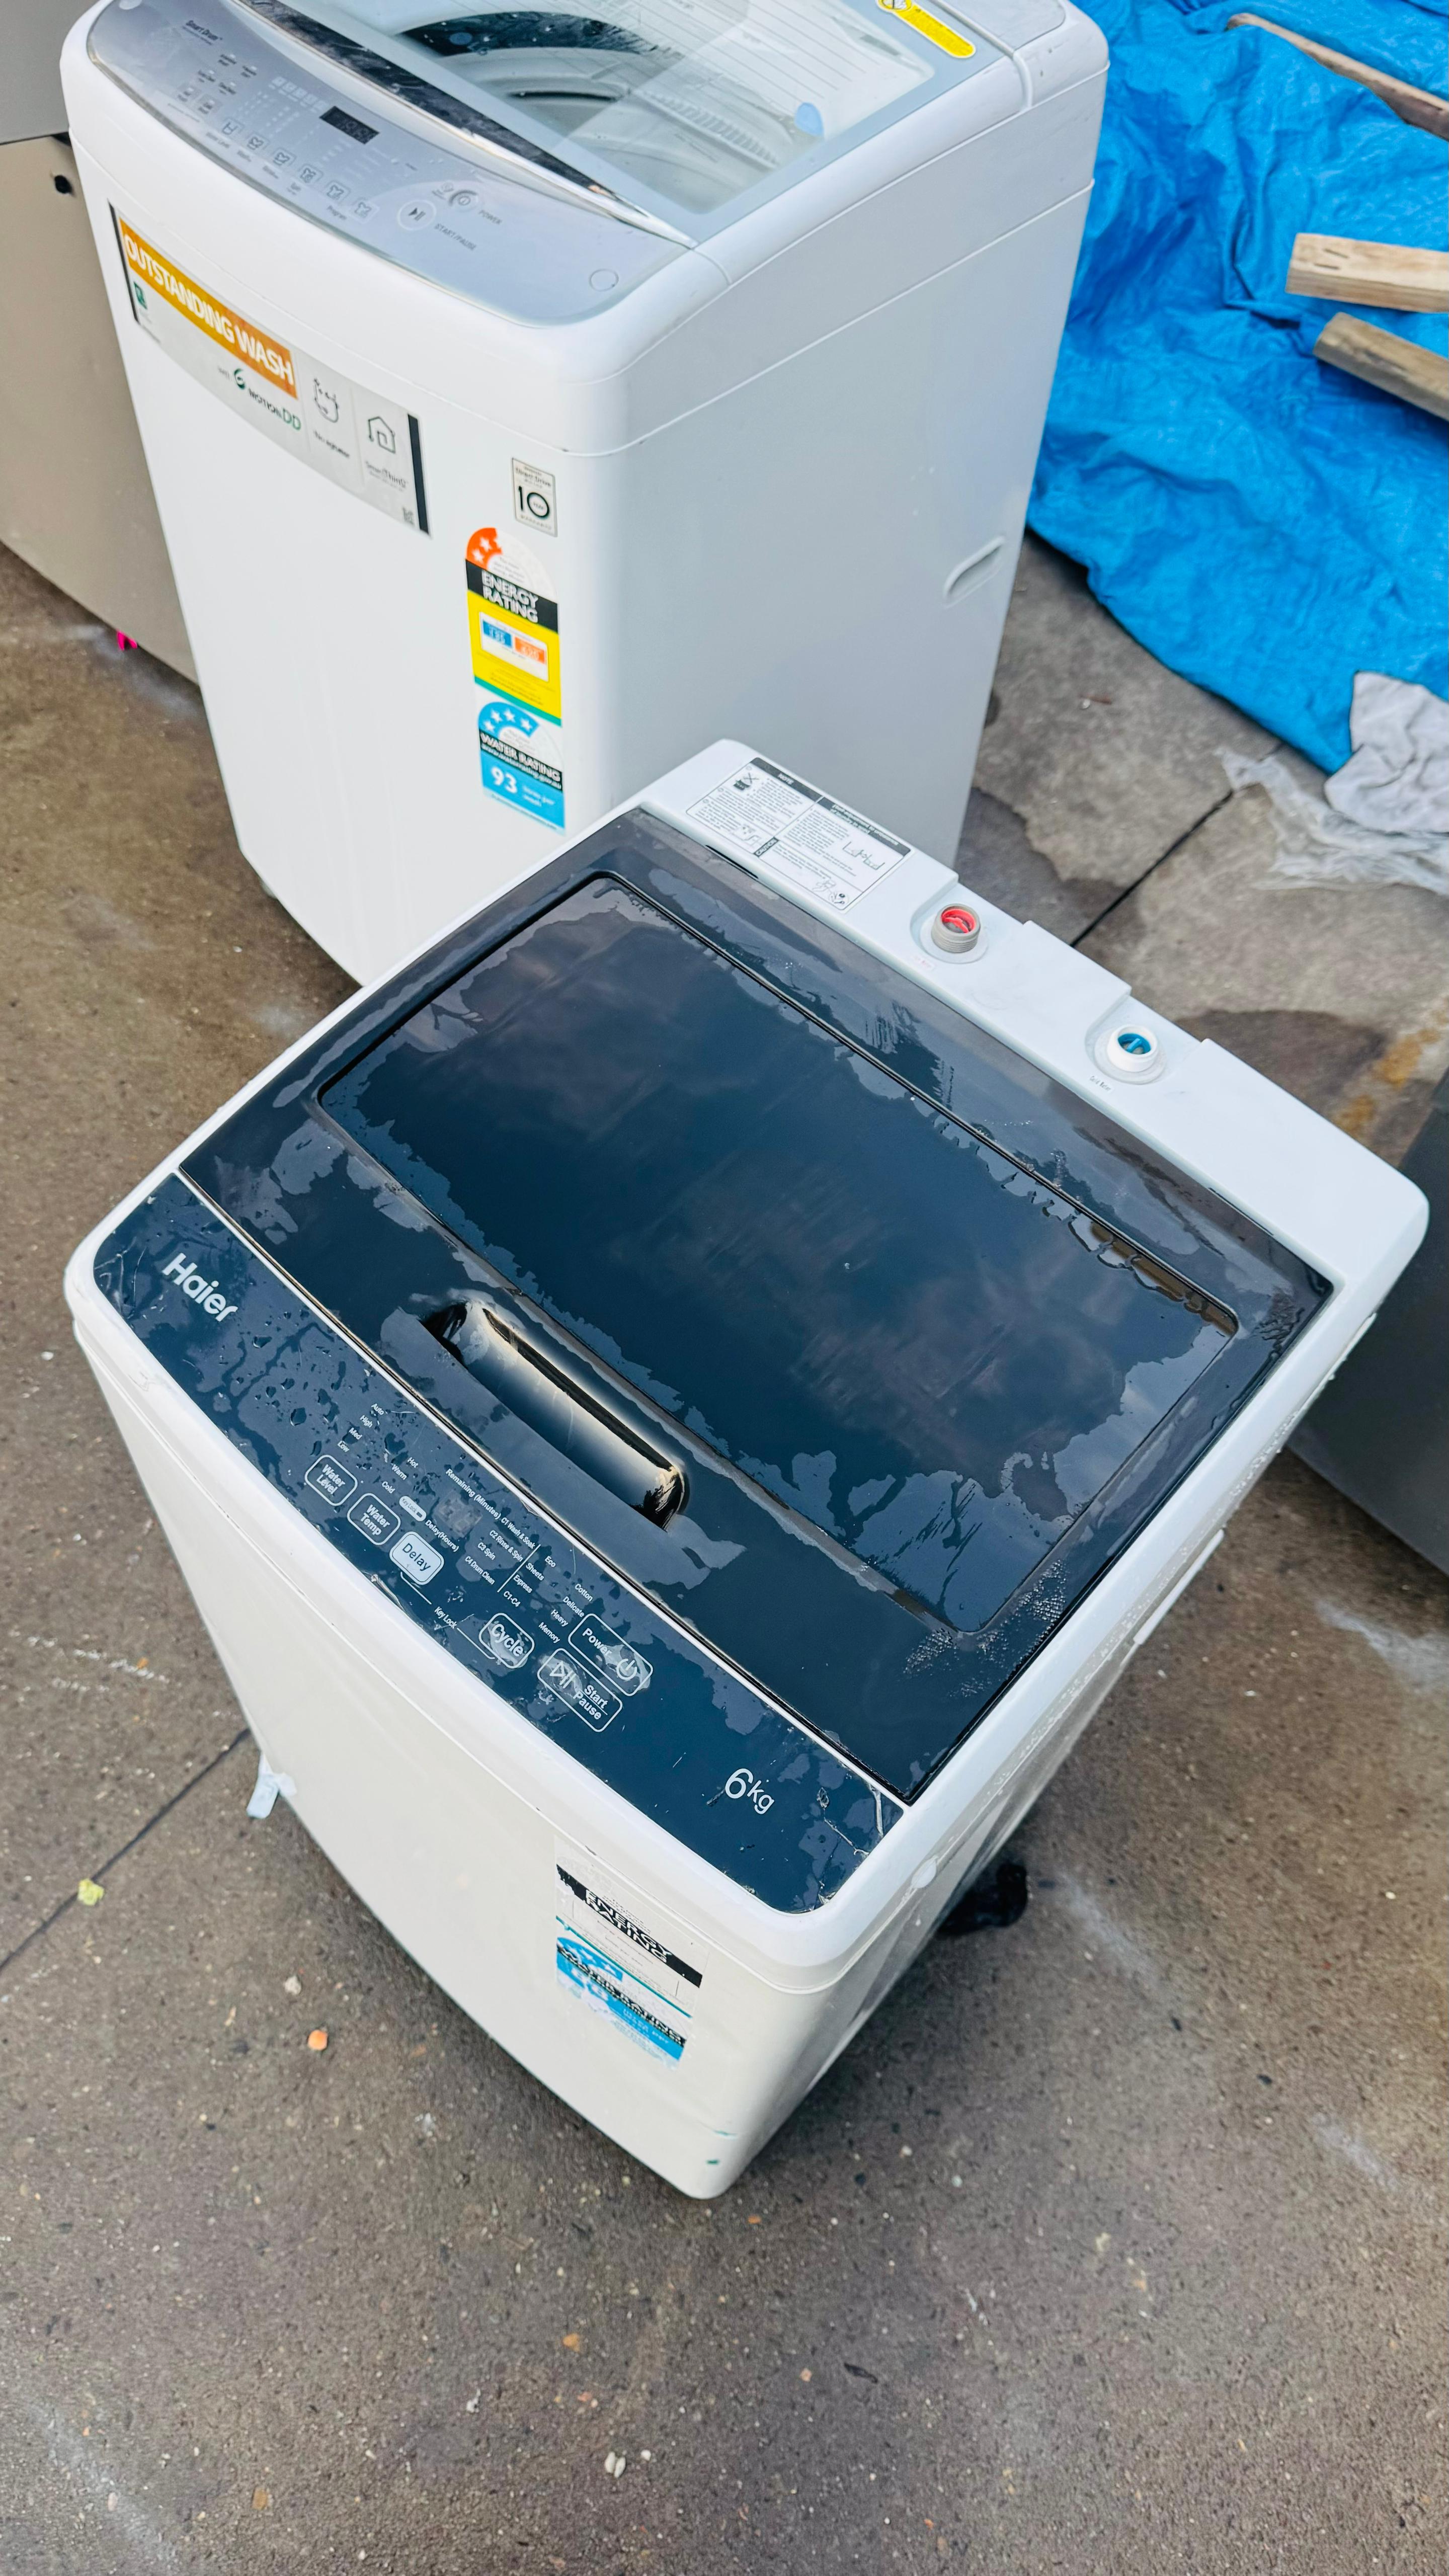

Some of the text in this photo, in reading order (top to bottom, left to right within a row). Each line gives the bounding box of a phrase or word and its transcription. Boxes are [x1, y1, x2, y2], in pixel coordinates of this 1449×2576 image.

[124, 233, 294, 385] OUTSTANDING WASH
[518, 486, 550, 519] 10
[481, 570, 538, 608] ENERGY
[483, 585, 538, 623] RATING
[480, 732, 518, 760] WATER
[518, 752, 560, 782] RATING
[491, 766, 518, 794] 93
[778, 773, 794, 785] NOTE
[162, 1252, 238, 1322] Haier
[371, 1403, 384, 1415] Auto
[360, 1415, 373, 1428] High
[349, 1427, 362, 1440] Med
[337, 1440, 350, 1453] Low
[392, 1464, 407, 1480] Warm
[407, 1457, 419, 1468] Hot
[316, 1474, 338, 1494] Level
[322, 1464, 346, 1486] Water
[381, 1481, 395, 1494] Cold
[446, 1469, 501, 1520] Remaining (Minutes)
[360, 1512, 382, 1536] Temp
[366, 1504, 390, 1528] Water
[501, 1517, 509, 1526] C1
[507, 1522, 520, 1538] Wash
[522, 1536, 536, 1549] Soak
[402, 1543, 431, 1571] Delay
[477, 1542, 496, 1560] C3 Spin
[490, 1530, 496, 1539] C2
[496, 1535, 510, 1550] Rinse
[511, 1549, 523, 1562] Spin
[465, 1556, 495, 1585] C4 Drum Clean
[526, 1563, 544, 1581] Sheets
[544, 1556, 556, 1567] Eco
[513, 1574, 532, 1593] Express
[575, 1583, 593, 1602] Cotton
[503, 1591, 521, 1607] C1-C4
[562, 1596, 584, 1618] Delicate
[434, 1606, 457, 1629] Key Lock
[550, 1609, 569, 1627] Heavy
[491, 1624, 524, 1657] Cycle
[538, 1622, 560, 1644] Memory
[583, 1628, 612, 1656] Power
[573, 1691, 601, 1720] Pause
[584, 1685, 608, 1709] Start
[586, 1889, 672, 1955] ENERGY
[586, 1899, 667, 1963] RATING
